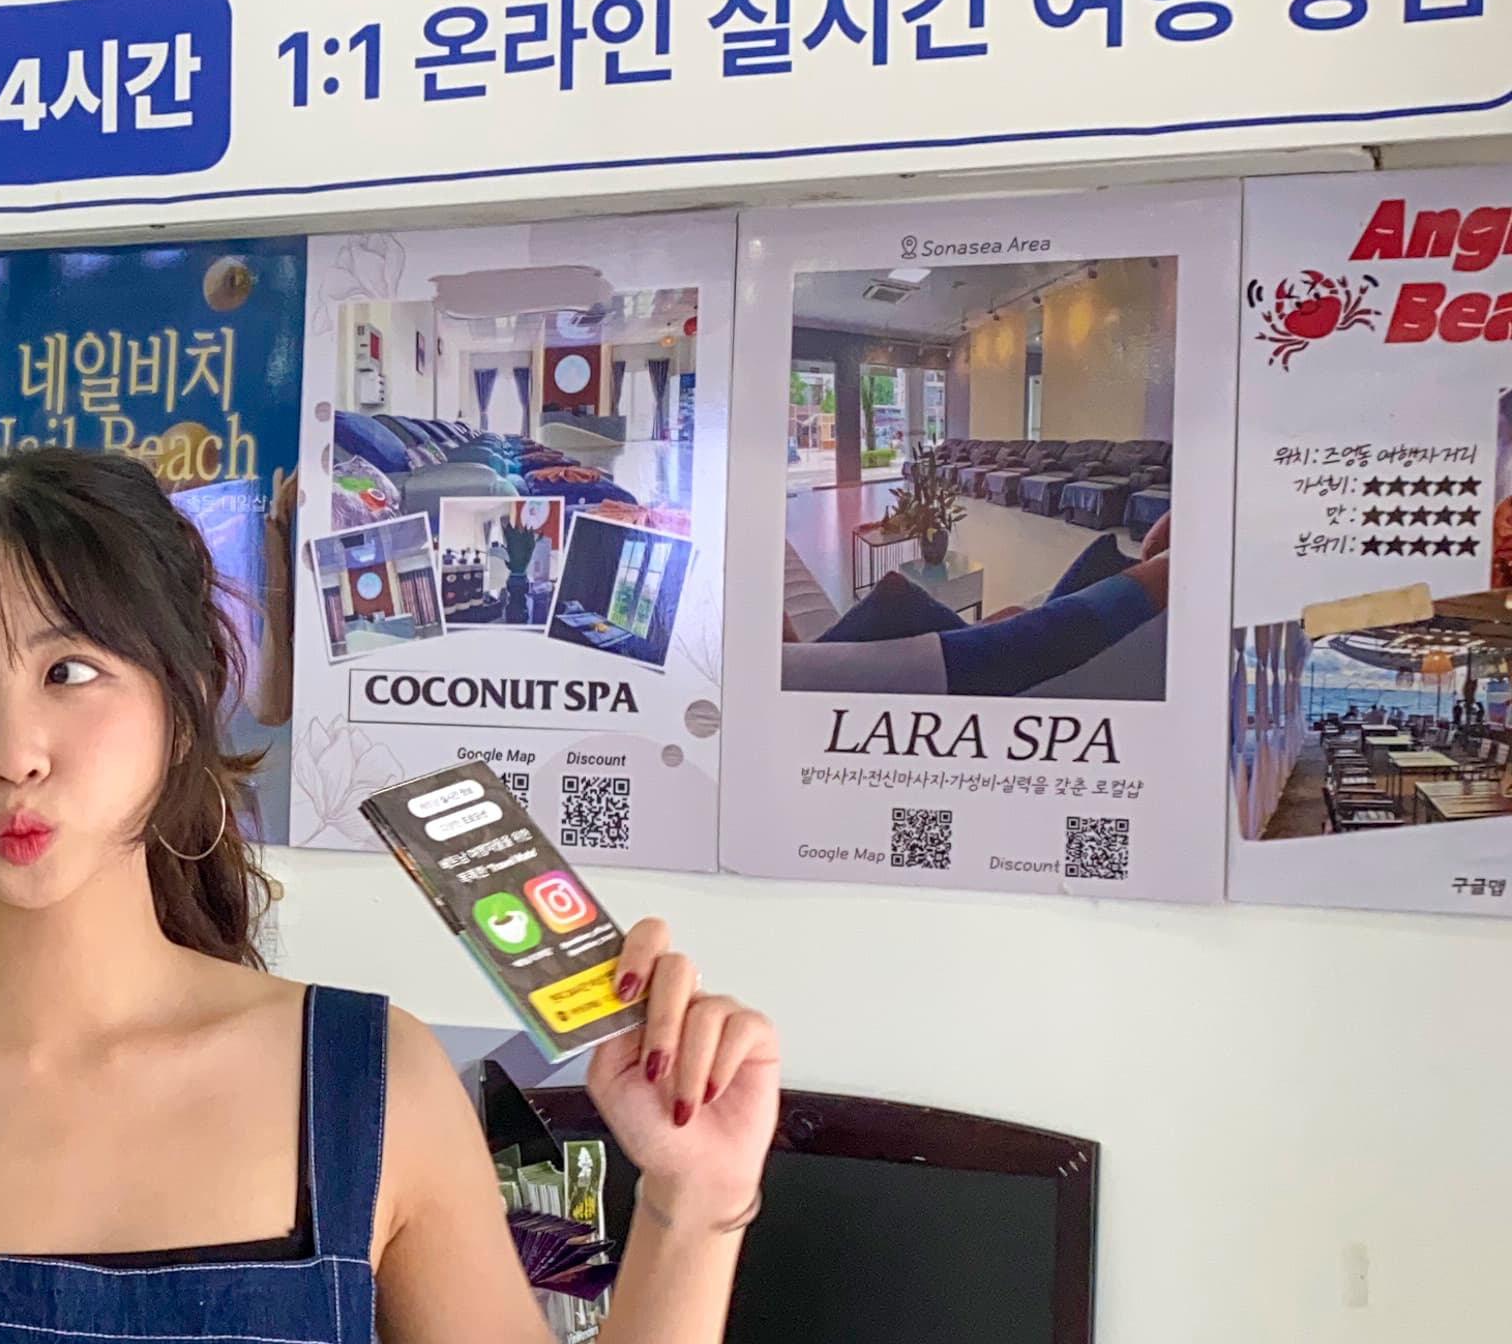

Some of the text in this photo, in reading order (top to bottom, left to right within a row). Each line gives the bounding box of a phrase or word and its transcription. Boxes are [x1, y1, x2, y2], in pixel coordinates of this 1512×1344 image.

[276, 30, 384, 108] 1:1
[921, 236, 1052, 257] Sonasea Area
[1348, 199, 1512, 272] Ang
[1384, 282, 1512, 344] Bea
[19, 327, 234, 414] 네일비치
[364, 675, 639, 714] COCONUT SPA
[824, 709, 1121, 764] LARA SPA
[457, 747, 536, 764] Google Map
[566, 752, 626, 766] Discount
[1055, 777, 1088, 797] 갖춘
[1091, 780, 1145, 799] 로컬샵
[797, 845, 886, 865] Google Map
[989, 856, 1061, 874] Discount
[1452, 877, 1507, 897] 구글맵
